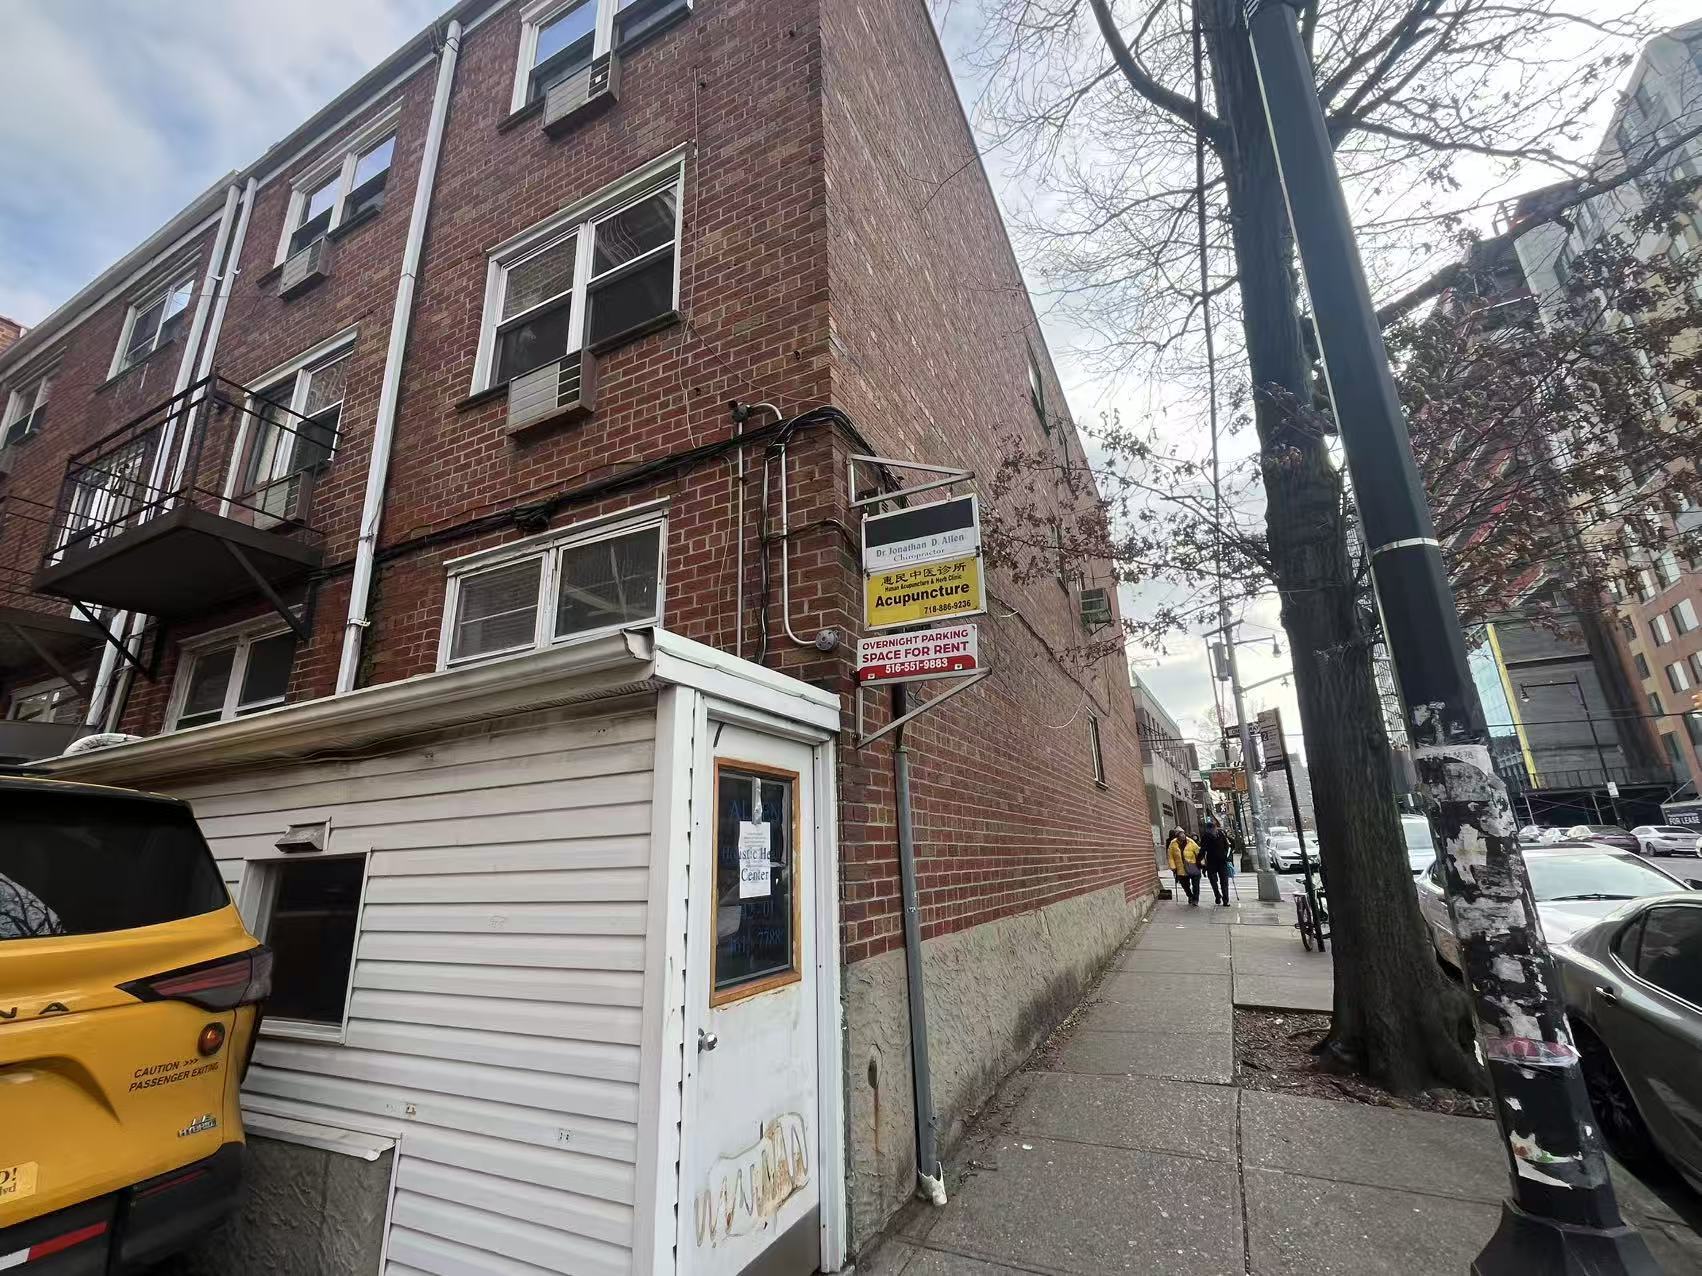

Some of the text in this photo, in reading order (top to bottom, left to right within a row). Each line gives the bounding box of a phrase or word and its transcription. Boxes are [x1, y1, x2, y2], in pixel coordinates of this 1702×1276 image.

[889, 541, 927, 555] Jonathan
[931, 538, 941, 547] D.
[942, 534, 965, 545] Allen
[893, 548, 945, 562] Chiropractor
[881, 562, 967, 587] 惠民中医诊所
[875, 583, 970, 608] Acupuncture
[862, 629, 969, 651] OVERNIGHT PARKING
[862, 641, 969, 663] SPACE FOR RENT
[885, 658, 948, 674] 516-551-9883
[741, 868, 770, 882] Center
[128, 1062, 220, 1093] PASSENGER EXITING
[134, 1061, 180, 1078] CAUTION
